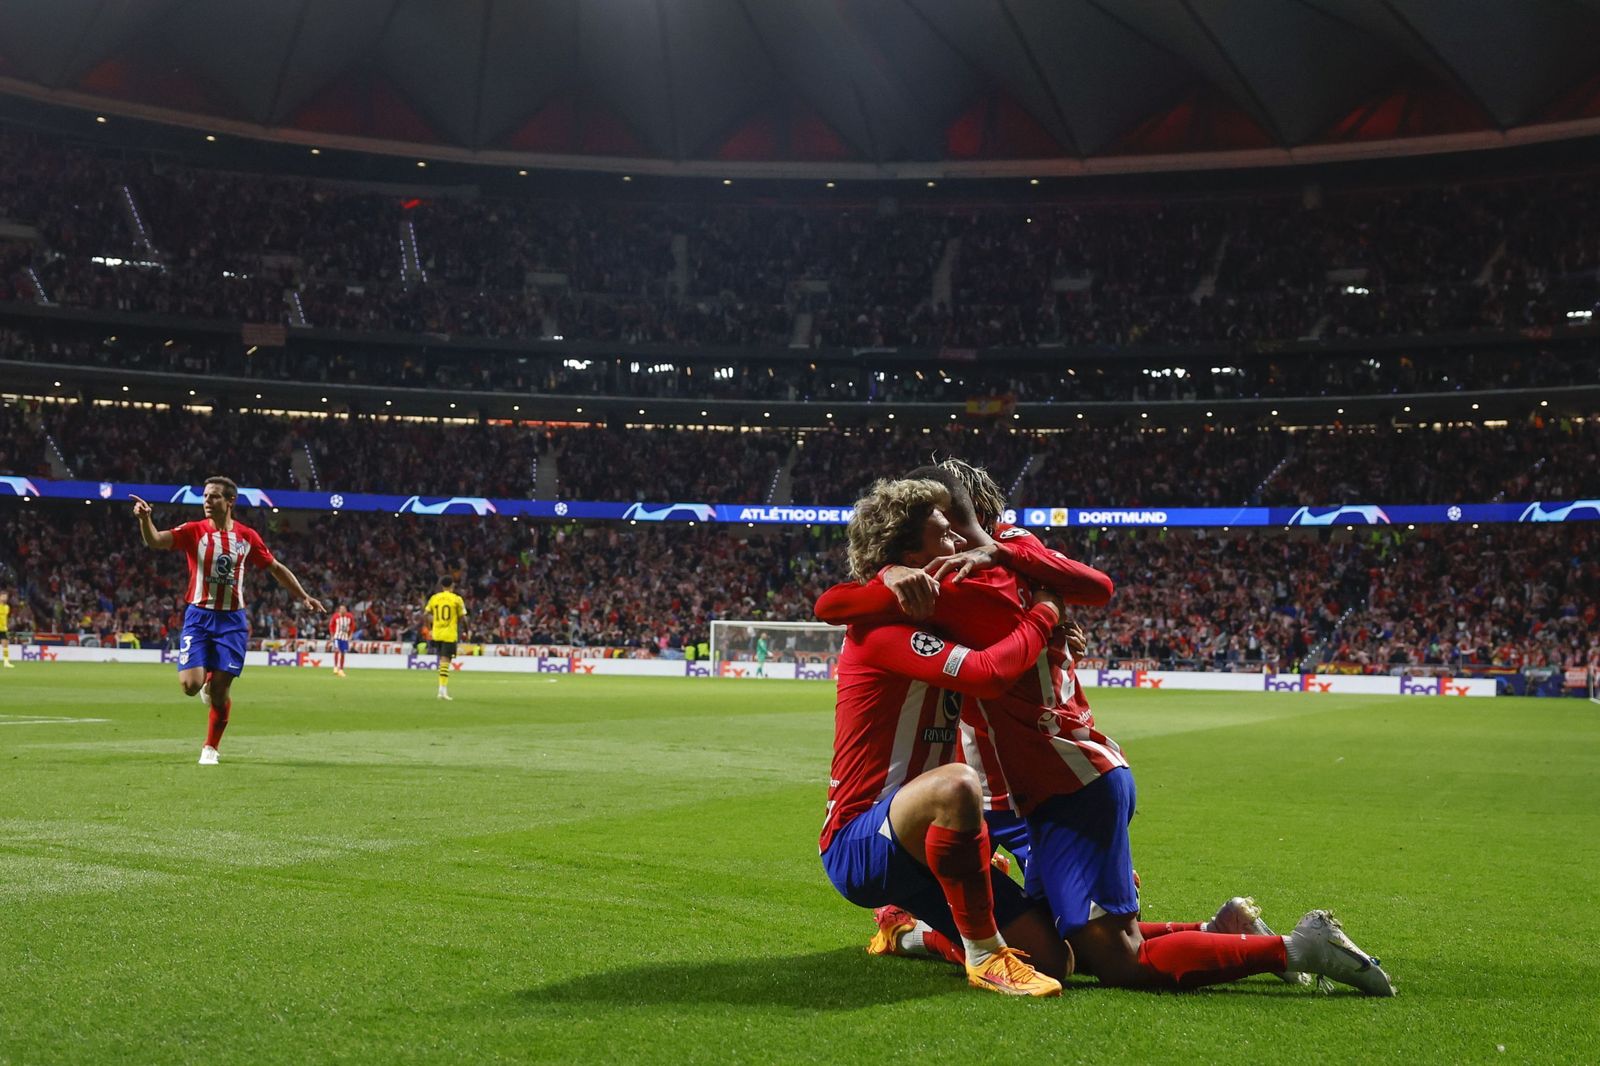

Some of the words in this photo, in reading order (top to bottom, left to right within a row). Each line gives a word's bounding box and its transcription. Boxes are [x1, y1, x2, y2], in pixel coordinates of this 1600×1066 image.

[740, 507, 817, 521] ATLÉTICO
[818, 510, 840, 521] DE
[1030, 510, 1046, 525] 0
[1078, 511, 1168, 524] DORTMUND
[435, 604, 451, 621] 10
[180, 635, 194, 653] 3
[21, 645, 58, 661] FedEx
[268, 652, 322, 667] FedEx
[407, 655, 464, 672] Fedx
[538, 657, 595, 675] FedEx
[1097, 669, 1164, 688] FedEx
[1264, 673, 1333, 692] FedEx
[1400, 675, 1471, 696] FedEx
[923, 728, 955, 742] RIYAD
